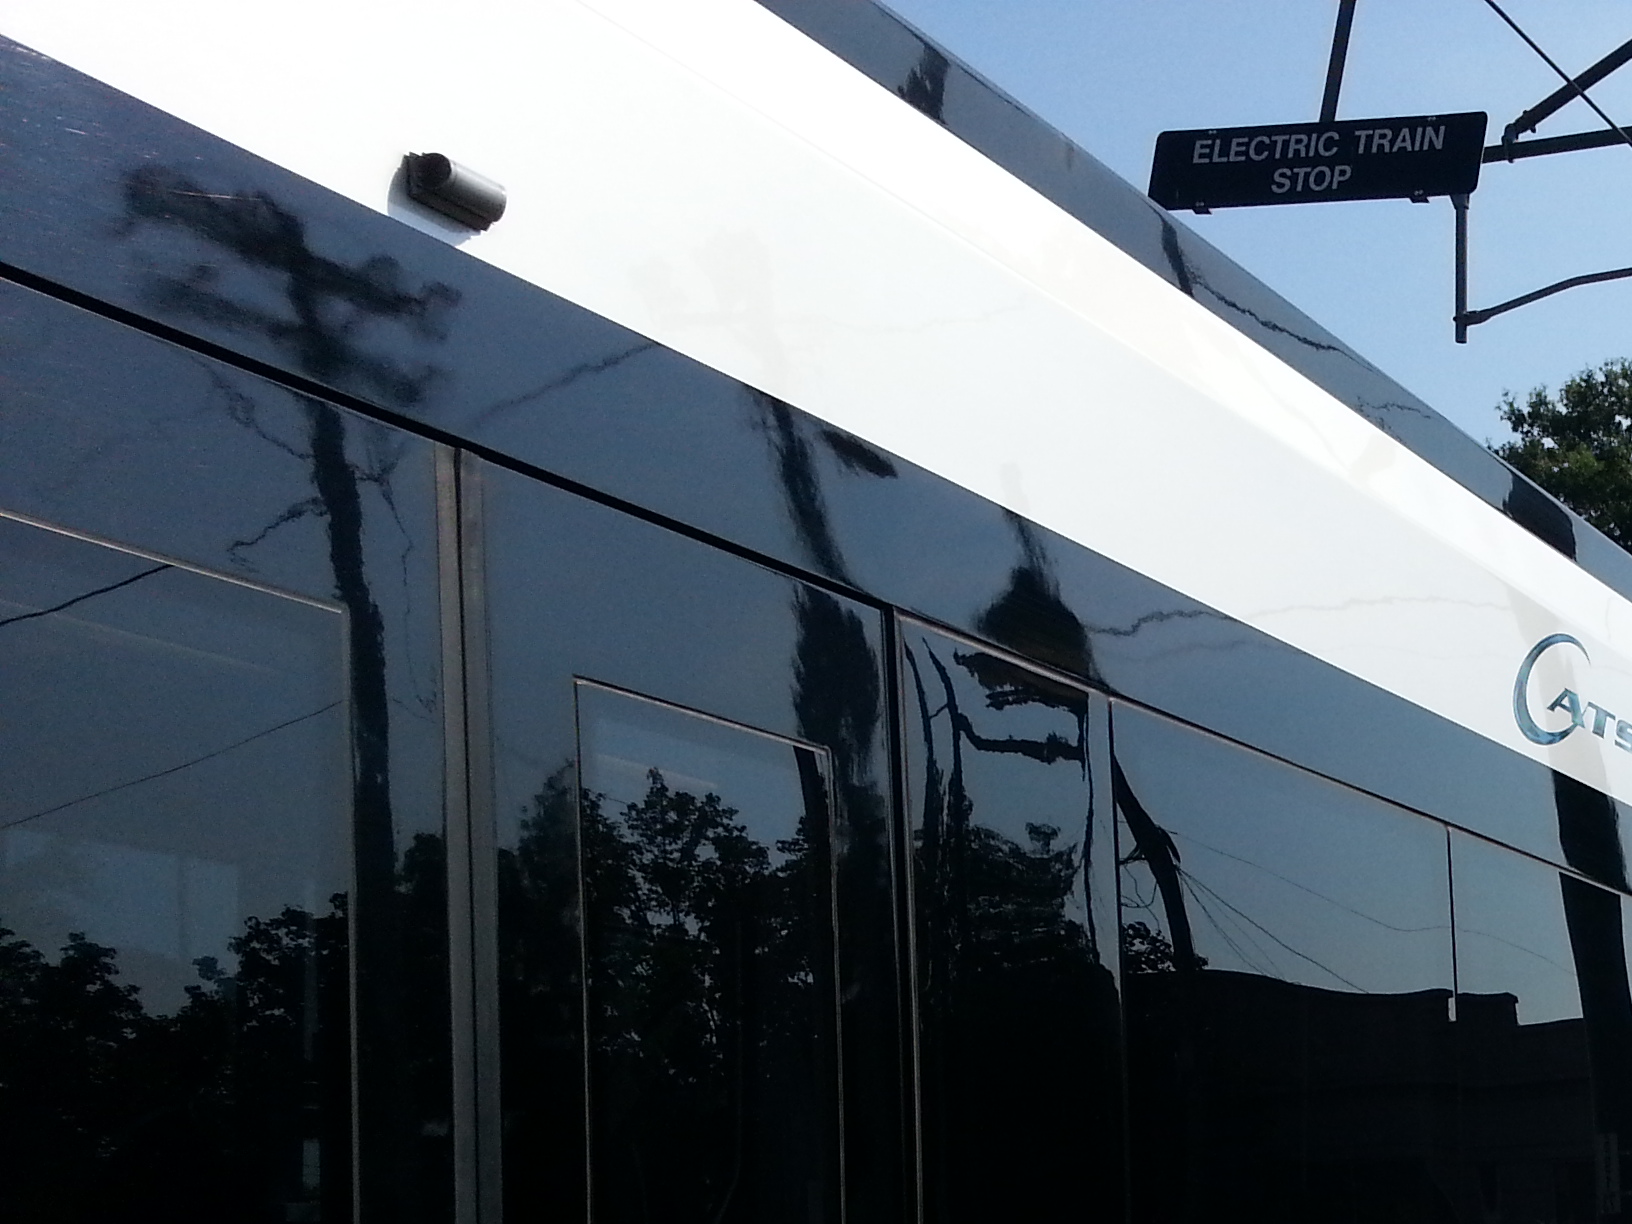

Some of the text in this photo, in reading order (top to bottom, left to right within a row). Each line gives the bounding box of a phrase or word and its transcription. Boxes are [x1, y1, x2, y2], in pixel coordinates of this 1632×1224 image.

[1192, 125, 1446, 164] ELECTRIC TRAIN
[1271, 164, 1352, 195] STOP
